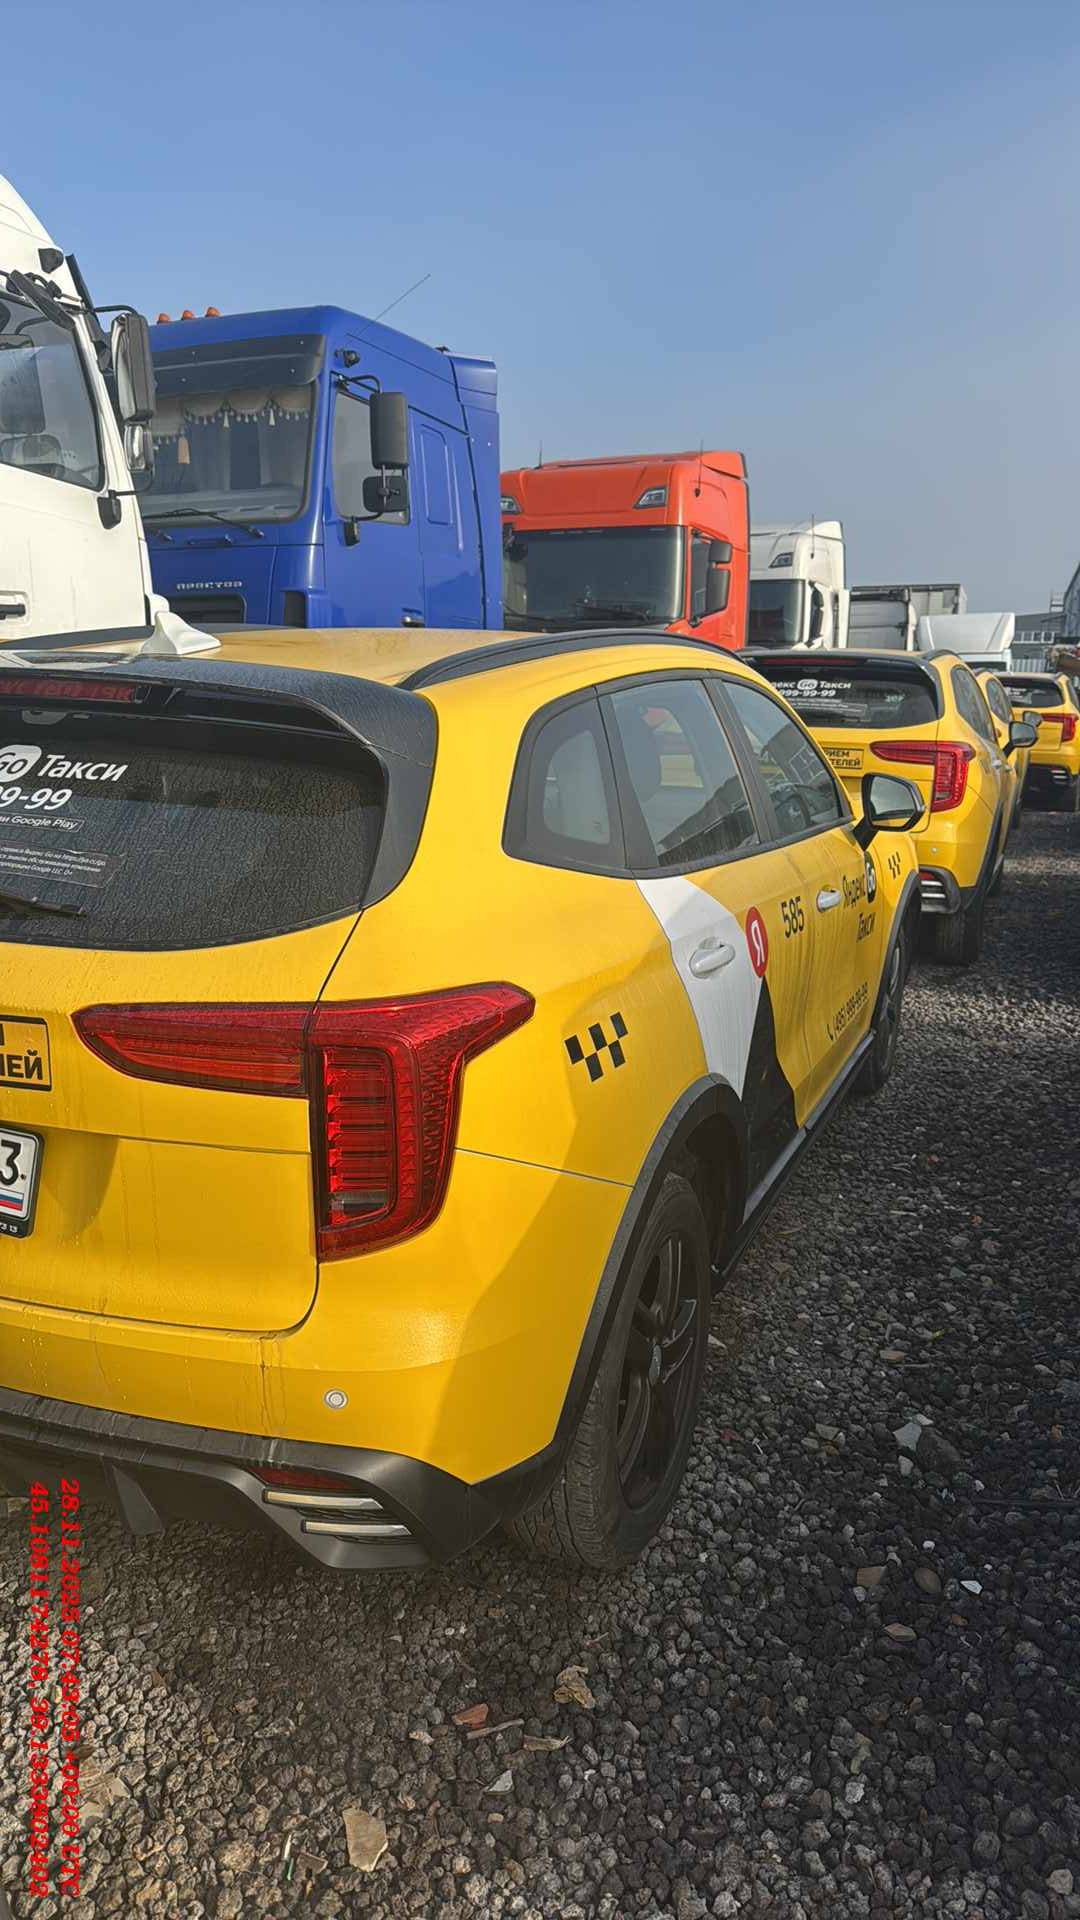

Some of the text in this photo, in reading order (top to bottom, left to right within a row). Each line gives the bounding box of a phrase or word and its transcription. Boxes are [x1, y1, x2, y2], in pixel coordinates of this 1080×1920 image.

[819, 680, 852, 689] Такси
[37, 753, 129, 781] Такси
[11, 815, 51, 827] Google
[52, 818, 79, 830] Play
[781, 896, 805, 938] 585
